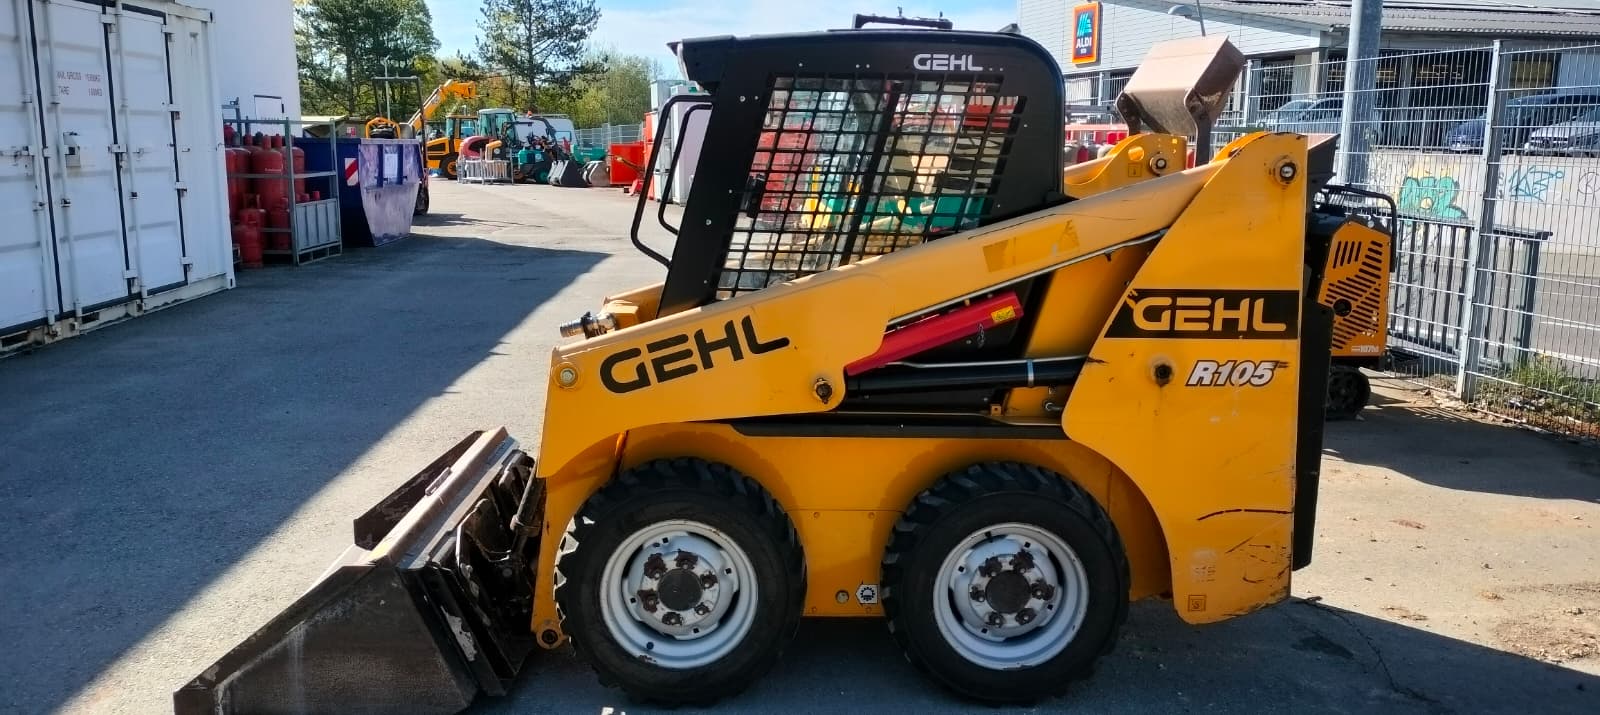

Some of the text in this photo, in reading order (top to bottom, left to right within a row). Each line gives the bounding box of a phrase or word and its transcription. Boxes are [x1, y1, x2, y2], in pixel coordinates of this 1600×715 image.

[1076, 37, 1092, 48] ALDI
[913, 53, 983, 71] GEHL
[1133, 296, 1287, 332] GEHL
[600, 315, 790, 393] GEHL
[1185, 360, 1281, 387] R105
